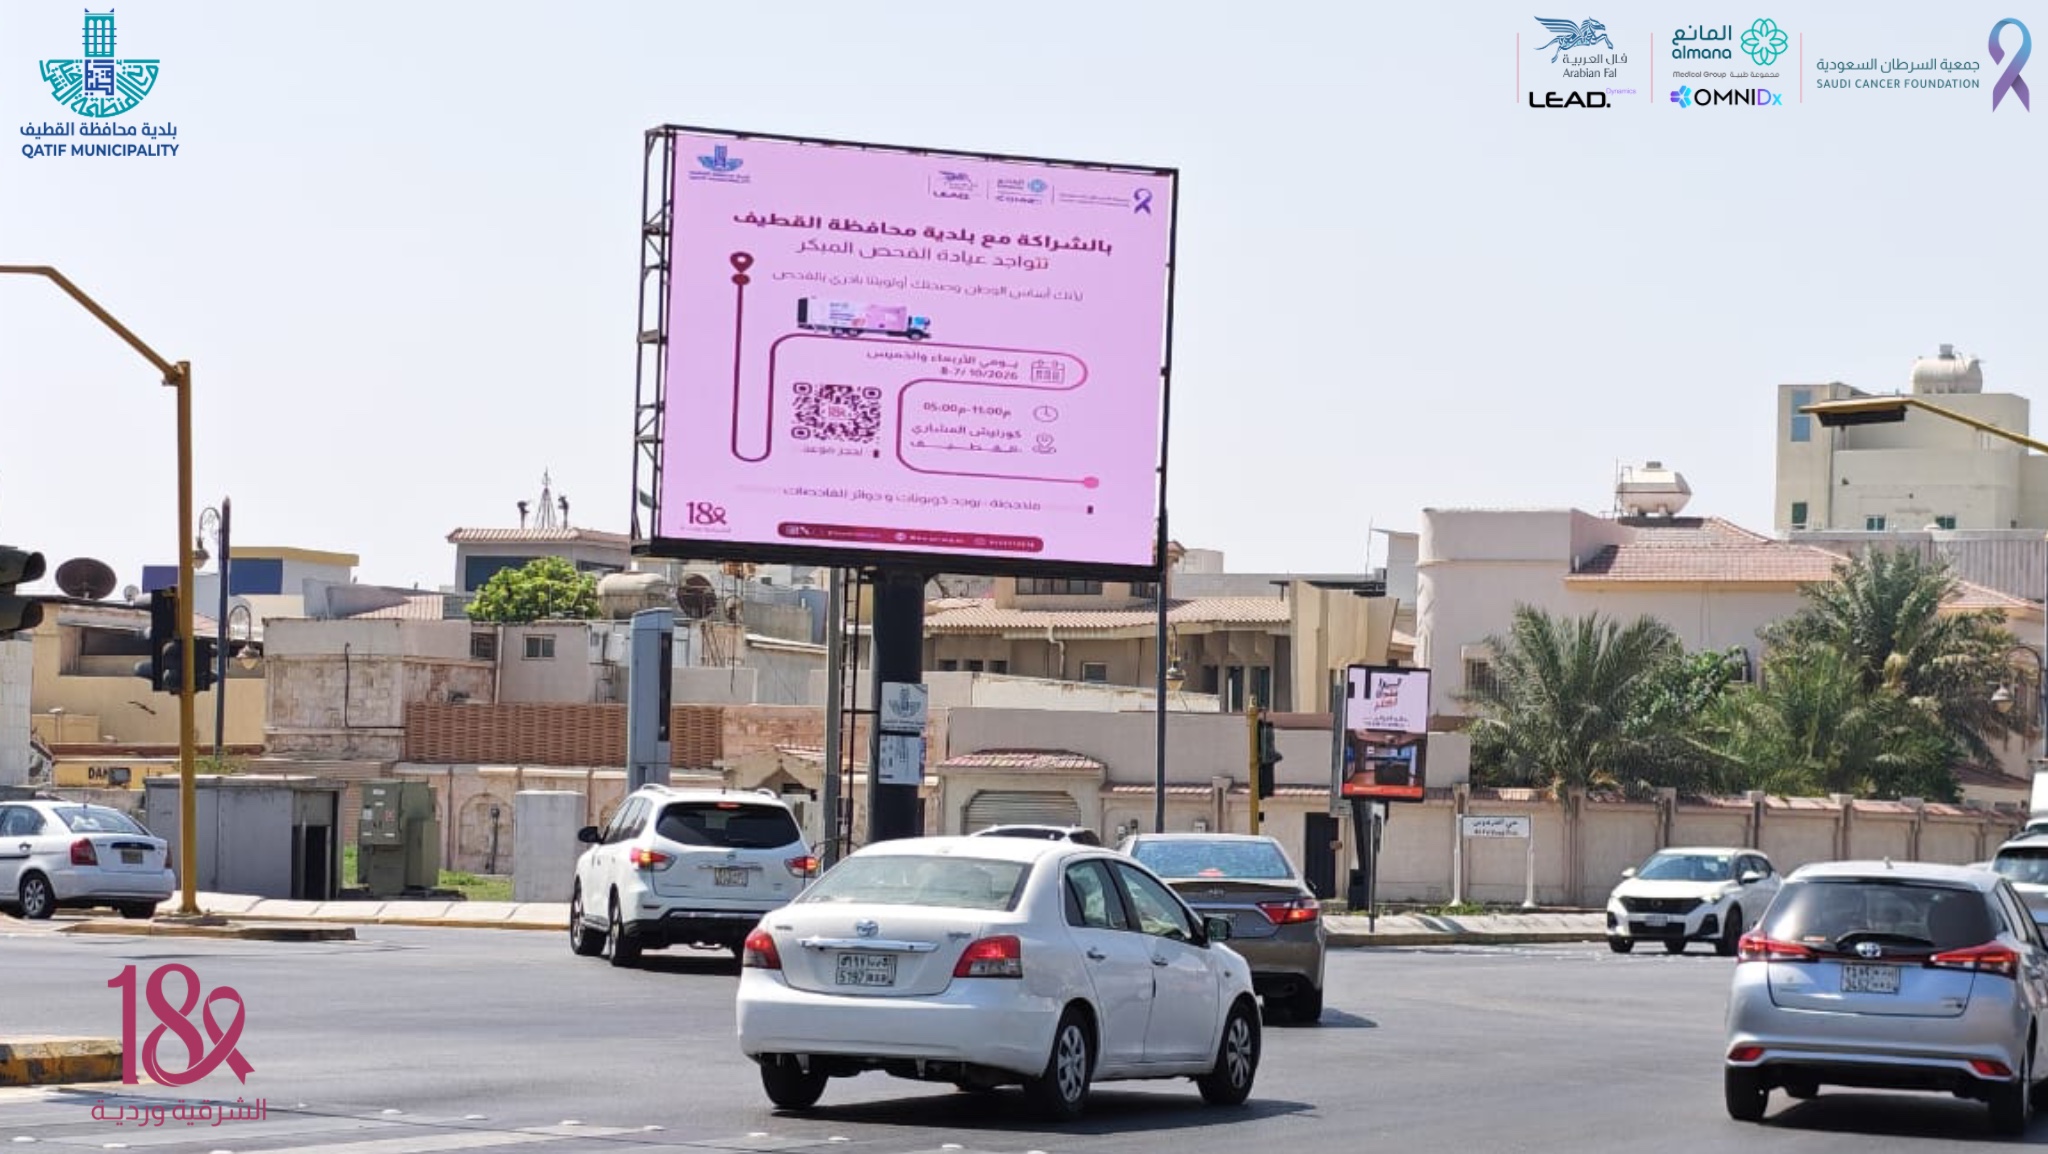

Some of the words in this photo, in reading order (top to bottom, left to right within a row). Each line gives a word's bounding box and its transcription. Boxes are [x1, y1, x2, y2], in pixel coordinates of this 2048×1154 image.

[733, 211, 822, 229] القطيف
[828, 217, 916, 238] محافظة
[923, 226, 975, 243] بلدية
[981, 234, 1011, 248] مع
[795, 238, 853, 254] المبكر
[858, 245, 931, 262] الفحص
[1017, 233, 1113, 257] بالشراكة
[936, 248, 987, 265] عيادة
[992, 254, 1049, 271] تتواجد
